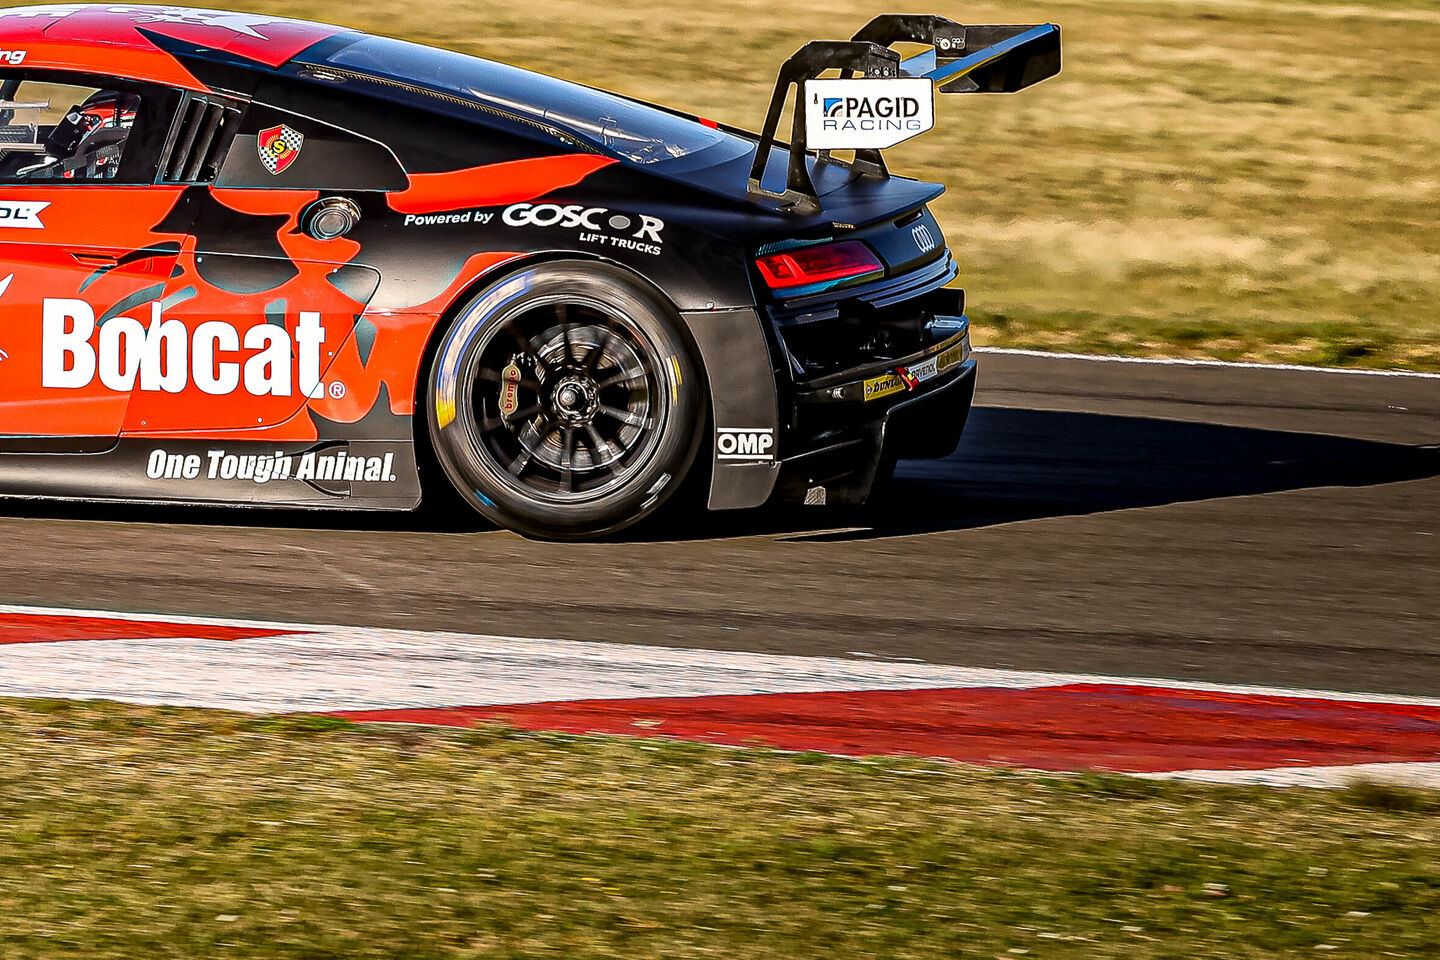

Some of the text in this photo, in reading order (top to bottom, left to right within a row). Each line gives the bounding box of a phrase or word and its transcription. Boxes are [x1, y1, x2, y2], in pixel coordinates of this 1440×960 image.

[846, 97, 920, 118] PAGID
[823, 119, 921, 131] RACING
[403, 212, 471, 227] Powered
[473, 211, 494, 225] by
[579, 232, 662, 256] LIFT TRUCKS
[42, 297, 326, 400] Bobcat
[717, 433, 774, 454] OMP
[146, 449, 201, 480] One
[207, 449, 294, 484] Tough
